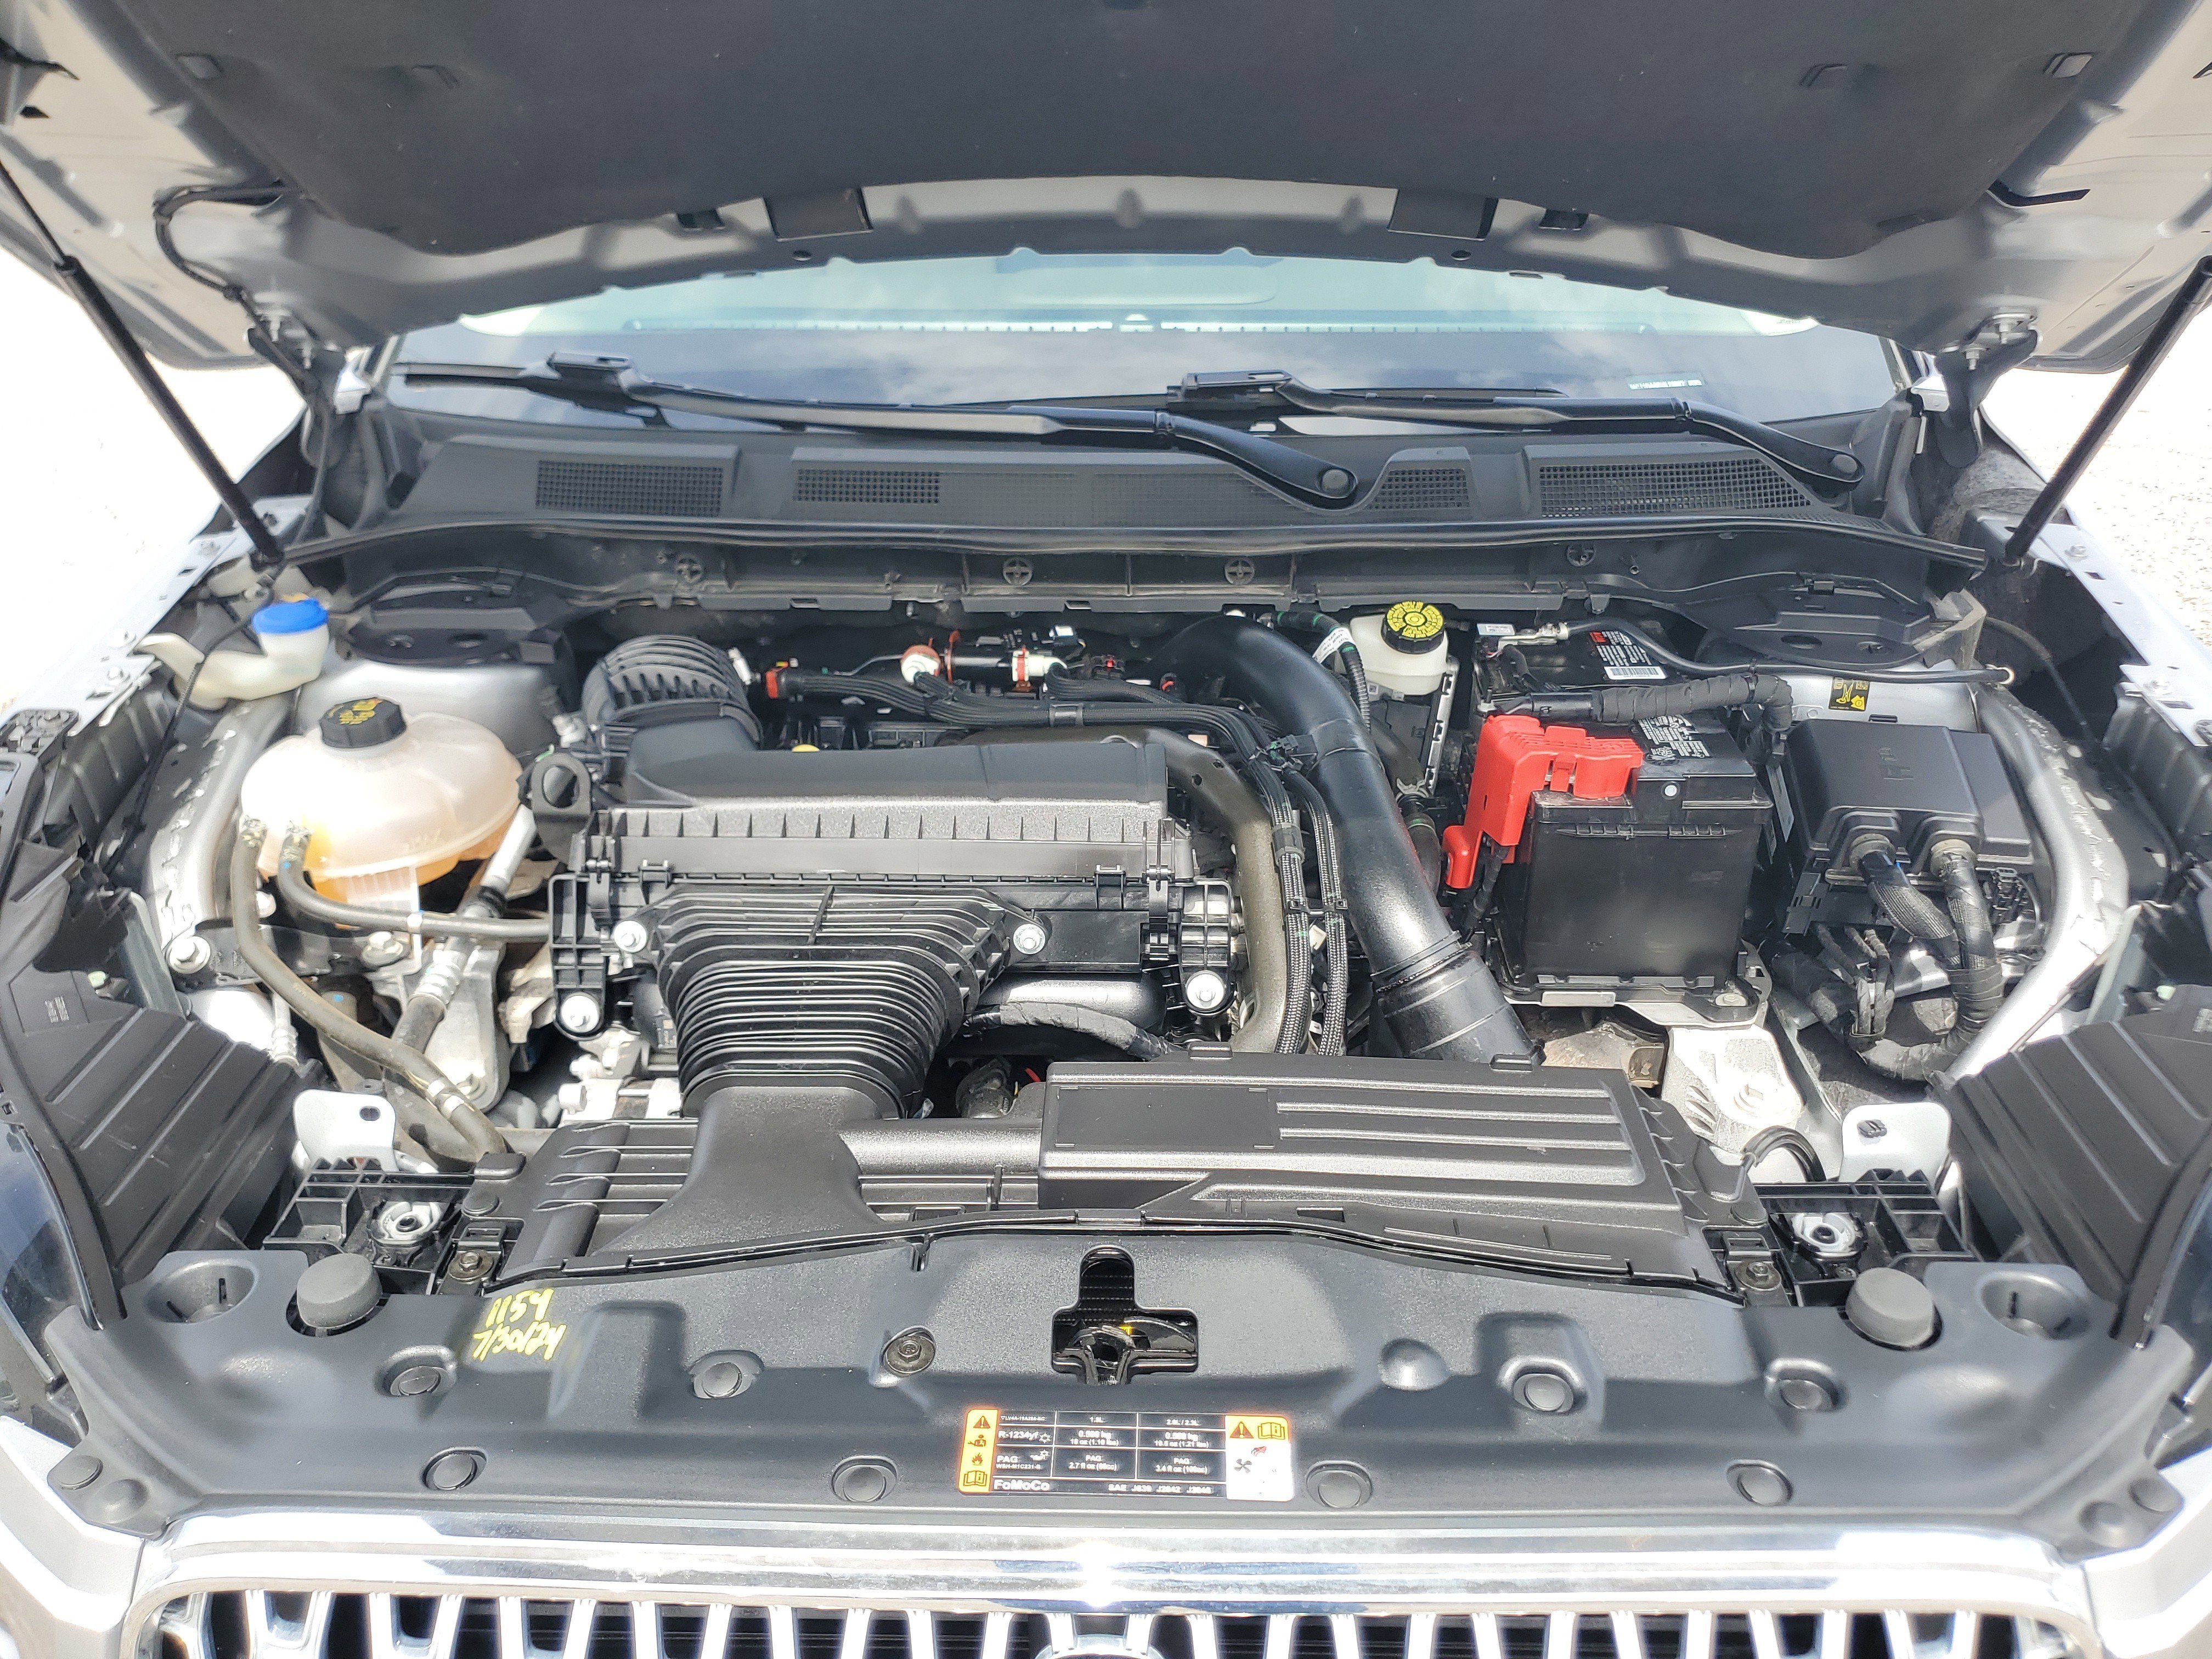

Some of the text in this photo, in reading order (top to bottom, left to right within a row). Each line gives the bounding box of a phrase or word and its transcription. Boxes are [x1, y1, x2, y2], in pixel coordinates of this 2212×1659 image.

[486, 1288, 555, 1328] 1154
[473, 1321, 567, 1361] 7/30/24
[998, 1430, 1039, 1440] R-1234yf
[996, 1455, 1018, 1463] PAG
[994, 1479, 1050, 1491] FoMoCo
[1108, 1483, 1127, 1492] SAE
